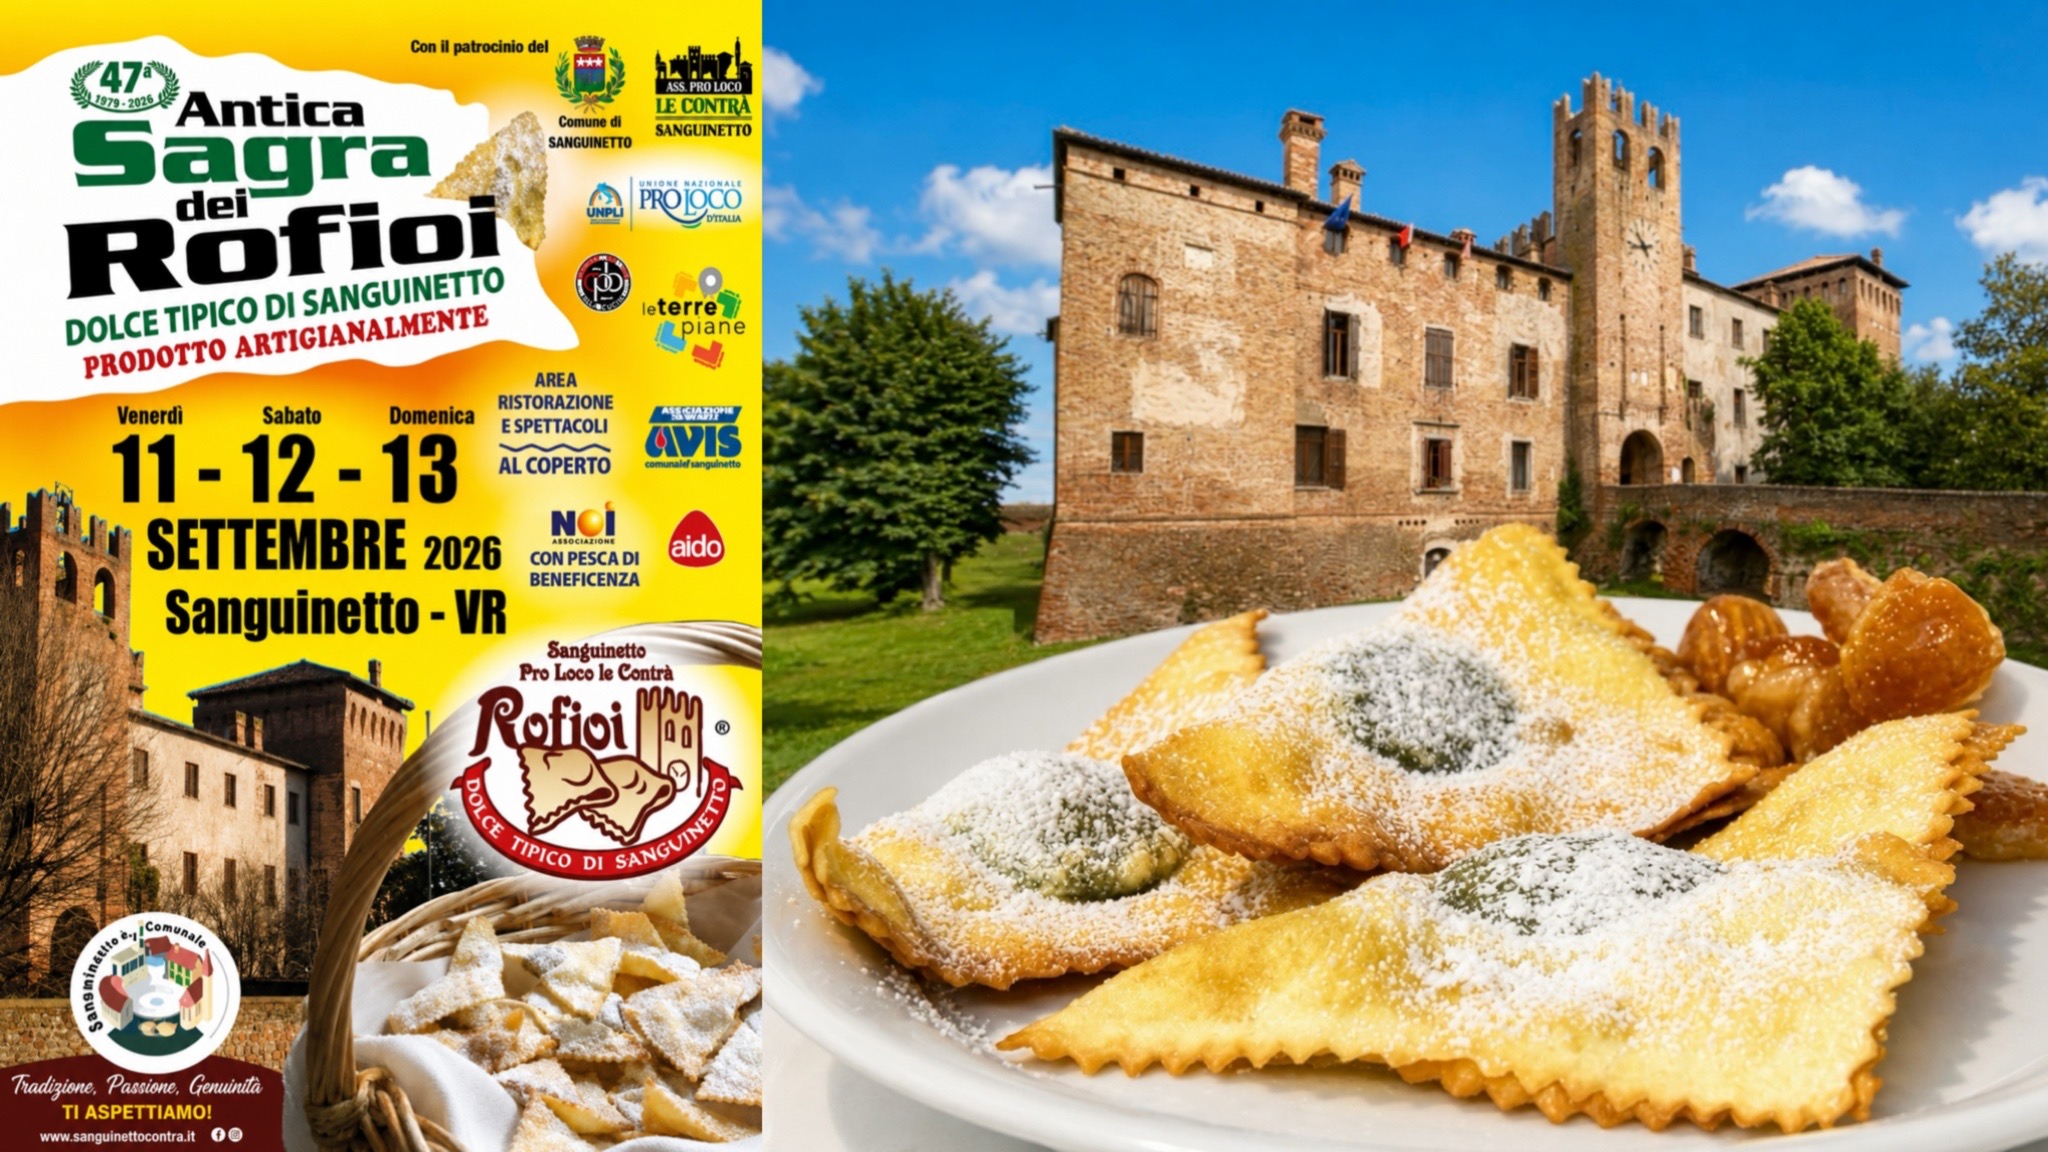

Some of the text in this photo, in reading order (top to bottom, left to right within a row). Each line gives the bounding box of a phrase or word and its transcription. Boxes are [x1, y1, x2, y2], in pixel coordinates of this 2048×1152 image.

[411, 40, 549, 56] Con il patrocinio del
[666, 81, 742, 92] ASS. PRO LOCO
[95, 94, 120, 108] 1979
[128, 94, 154, 108] 2026
[175, 91, 365, 127] Antica
[656, 95, 751, 116] LE CONTRÀ
[559, 115, 621, 128] Comune di
[655, 123, 752, 137] SANGUINETTO
[549, 136, 632, 149] SANGUINETTO
[72, 120, 431, 199] Sagra
[176, 188, 248, 222] dei
[639, 189, 742, 216] PRO LOCO
[587, 207, 624, 218] UNPLI
[707, 215, 742, 223] D'ITALIA
[63, 195, 500, 299] Rofioi
[65, 266, 505, 346] DOLCE TIPICO DI SANGUINETTO
[682, 316, 746, 341] piane
[83, 304, 489, 380] PRODOTTO ARTIGIANALMENTE
[535, 372, 577, 388] AREA
[498, 395, 613, 410] RISTORAZIONE
[117, 406, 183, 425] Venerdì
[262, 406, 322, 425] Sabato
[390, 406, 475, 425] Domenica
[502, 418, 608, 433] E SPETTACOLI
[645, 425, 742, 458] AVIS
[112, 434, 458, 504] 11 - 12 - 13
[499, 457, 611, 474] AL COPERTO
[690, 459, 741, 470] sanguinetto
[147, 518, 501, 571] SETTEMBRE 2026
[671, 534, 722, 558] aido
[530, 551, 639, 566] CON PESCA DI
[530, 572, 640, 587] BENEFICENZA
[165, 589, 507, 642] Sanguinetto - VR
[547, 640, 646, 663] Sanguinetto
[519, 663, 674, 682] Pro Loco le Contrà
[468, 685, 628, 757] Rofioi
[466, 777, 505, 839] DOLCE
[510, 835, 572, 869] TIPICO
[583, 856, 603, 870] DI
[145, 921, 206, 949] Comunale
[11, 1074, 263, 1101] Tradizione, Passione, Genuinità
[62, 1104, 212, 1120] TI ASPETTIAMO!
[40, 1130, 196, 1145] www.sanguinettocontra.it
